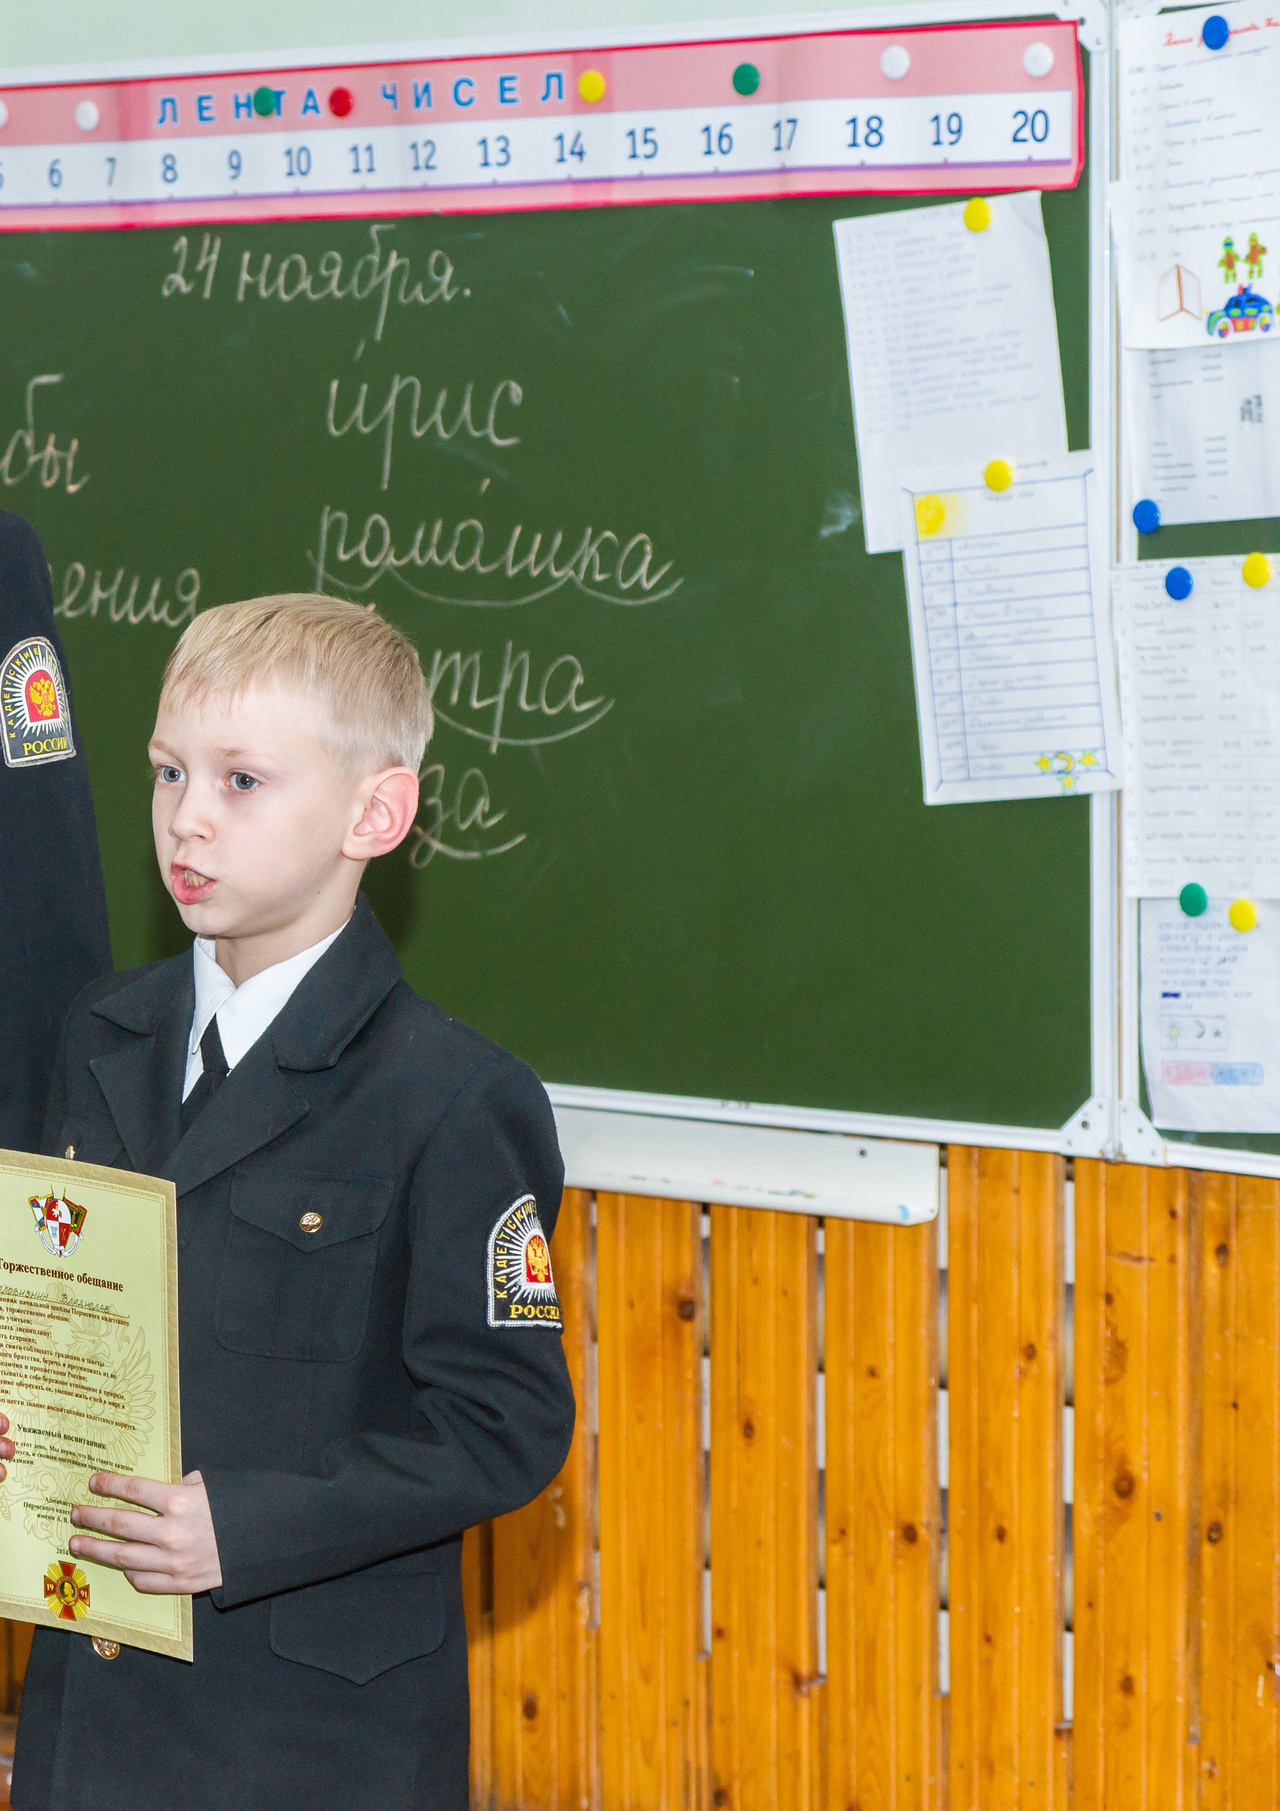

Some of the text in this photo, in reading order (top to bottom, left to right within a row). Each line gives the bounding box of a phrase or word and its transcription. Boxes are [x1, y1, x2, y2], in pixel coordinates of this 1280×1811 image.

[381, 72, 565, 111] ЧИСЕЛ
[48, 159, 63, 188] 6
[106, 157, 117, 186] 7
[162, 153, 178, 183] 8
[228, 150, 243, 180] 9
[284, 146, 312, 177] 10
[350, 143, 376, 174] 11
[410, 139, 438, 171] 12
[477, 135, 512, 167] 13
[554, 131, 587, 164] 14
[626, 127, 659, 160] 15
[701, 123, 734, 156] 16
[772, 118, 799, 151] 17
[845, 115, 884, 148] 18
[930, 112, 963, 145] 19
[1012, 110, 1049, 142] 20
[161, 233, 221, 299] 24
[3, 647, 39, 738] КАДЕТСКИЕ
[429, 640, 606, 754] тра
[23, 736, 68, 756] РОССИИ
[76, 1273, 124, 1292] обещание
[17, 1423, 62, 1439] Уважаемый
